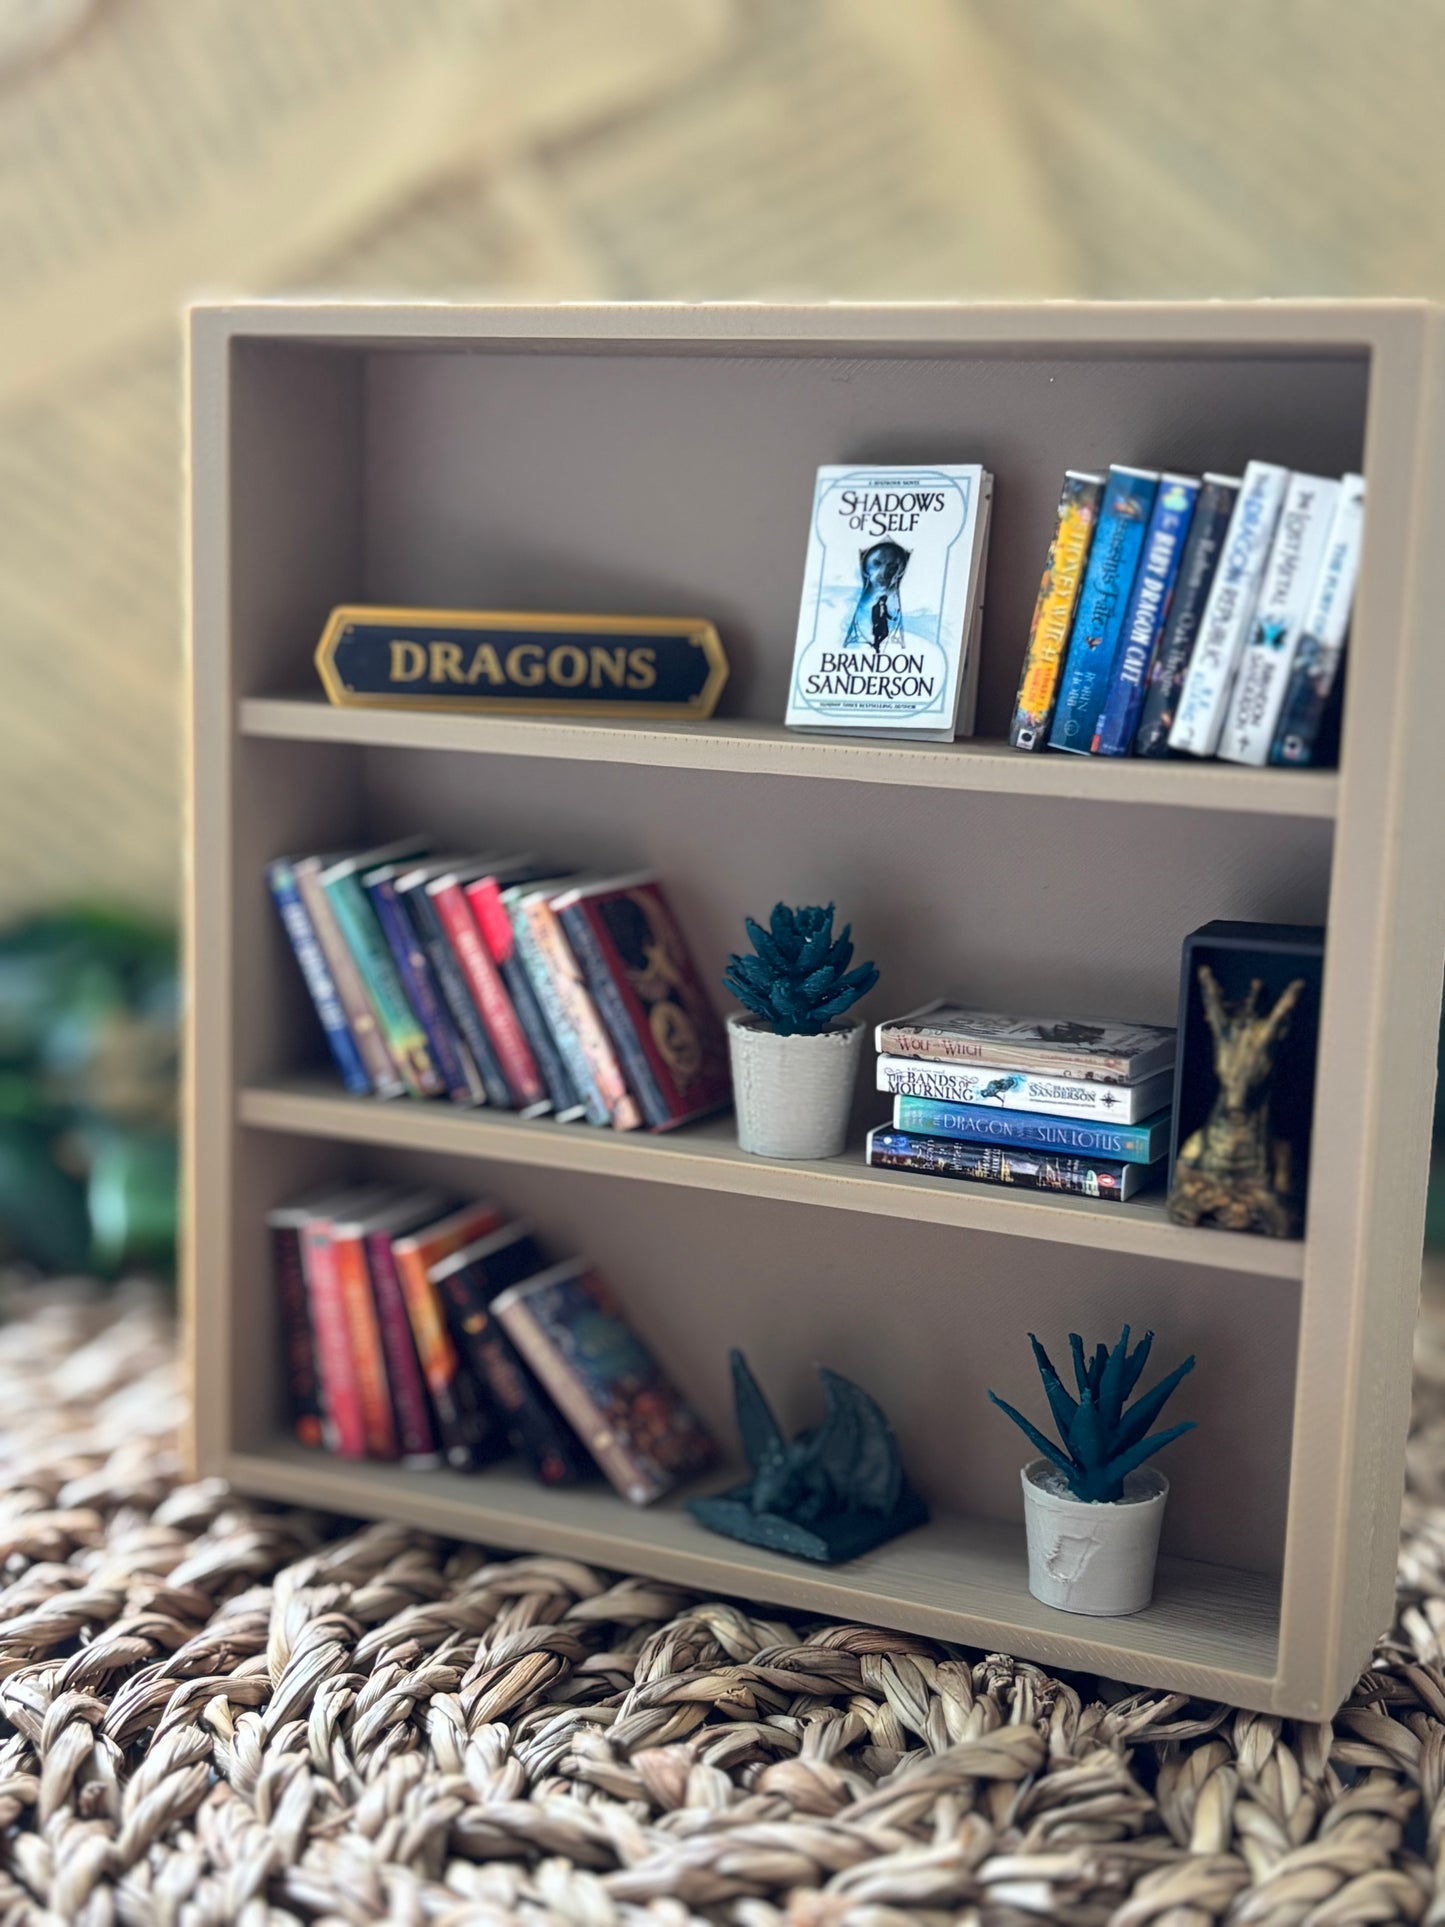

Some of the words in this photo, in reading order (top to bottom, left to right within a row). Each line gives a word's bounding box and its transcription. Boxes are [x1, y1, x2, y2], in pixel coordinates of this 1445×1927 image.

[838, 490, 945, 516] SHADOWS
[849, 513, 871, 531] OF
[869, 512, 920, 537] SELF
[1145, 530, 1176, 576] BABY
[1129, 576, 1164, 646] DRAGON
[1040, 601, 1070, 664] WITCH
[389, 639, 658, 690] DRAGONS
[820, 653, 924, 675] BRANDON
[805, 675, 934, 699] SANDERSON
[1075, 670, 1096, 712] ROBIN
[896, 1034, 930, 1051] WOLF
[942, 1039, 982, 1057] WITCH
[888, 1081, 974, 1102] MOURNING
[907, 1071, 957, 1088] BANDS
[1028, 1083, 1096, 1103] SANDERSON
[944, 1113, 1013, 1136] DRAGON
[1038, 1127, 1067, 1144] SUN
[1072, 1131, 1121, 1152] LOTUS
